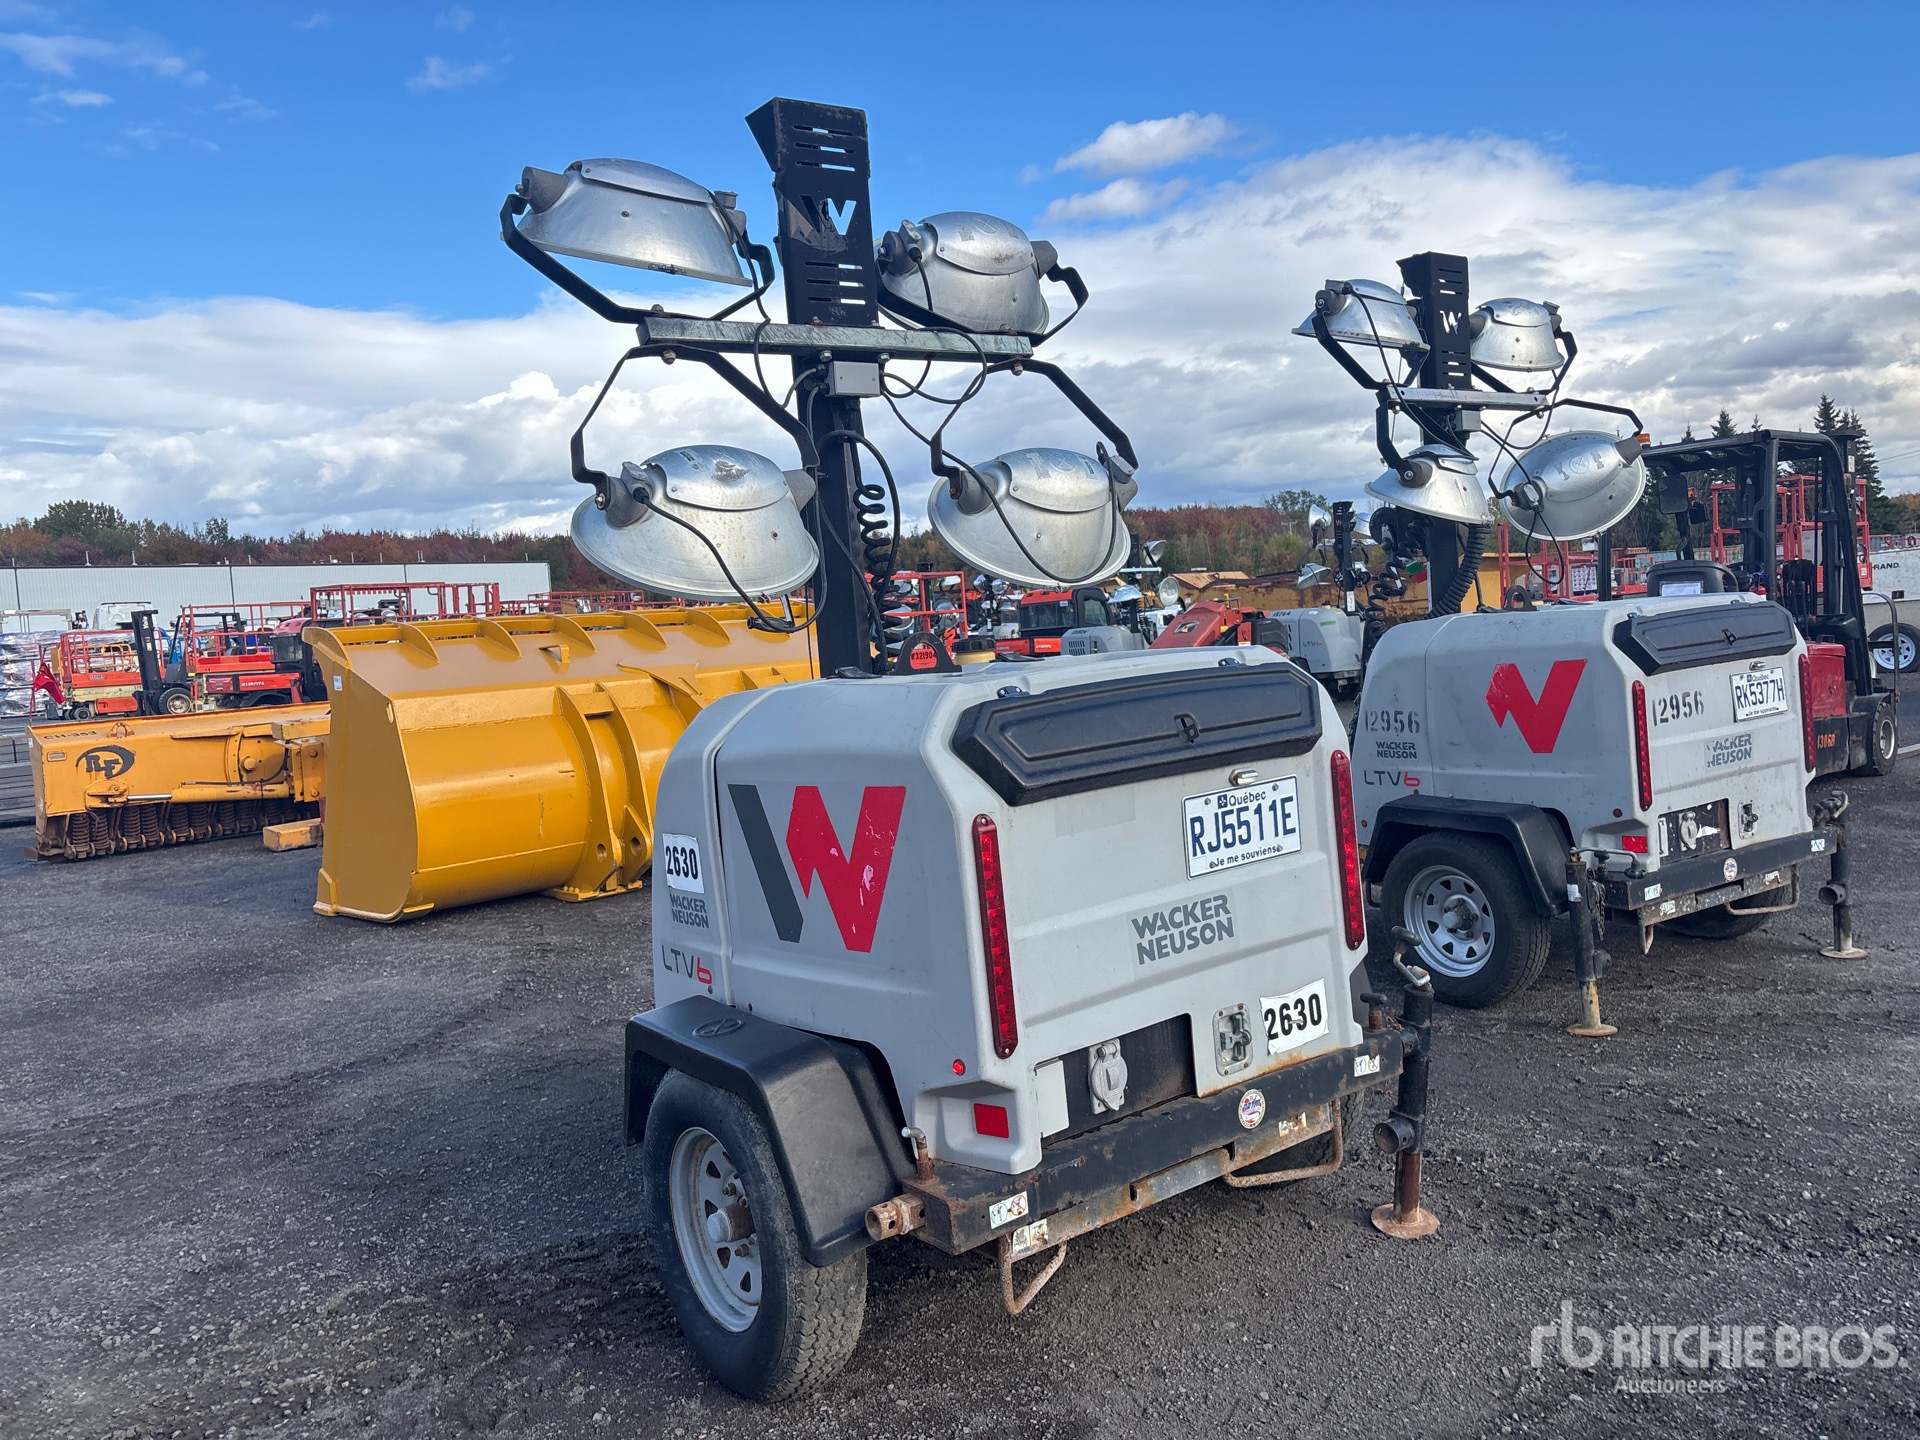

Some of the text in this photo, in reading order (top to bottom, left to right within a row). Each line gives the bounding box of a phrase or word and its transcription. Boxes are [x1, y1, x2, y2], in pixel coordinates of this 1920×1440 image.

[1735, 678, 1785, 709] RK5377H
[1365, 710, 1420, 734] 12956
[1652, 690, 1704, 727] 12956
[1376, 741, 1417, 751] WACKER
[1376, 750, 1417, 759] NEUSON
[1228, 791, 1267, 807] Québec
[1190, 795, 1297, 857] RJ5511E
[665, 845, 698, 880] 2630
[1215, 845, 1277, 867] Je me souviens
[670, 893, 707, 914] WACKER
[1131, 894, 1231, 940] WACKER
[671, 909, 709, 929] NEUSON
[1136, 917, 1234, 966] NEUSON
[1264, 993, 1322, 1041] 2630
